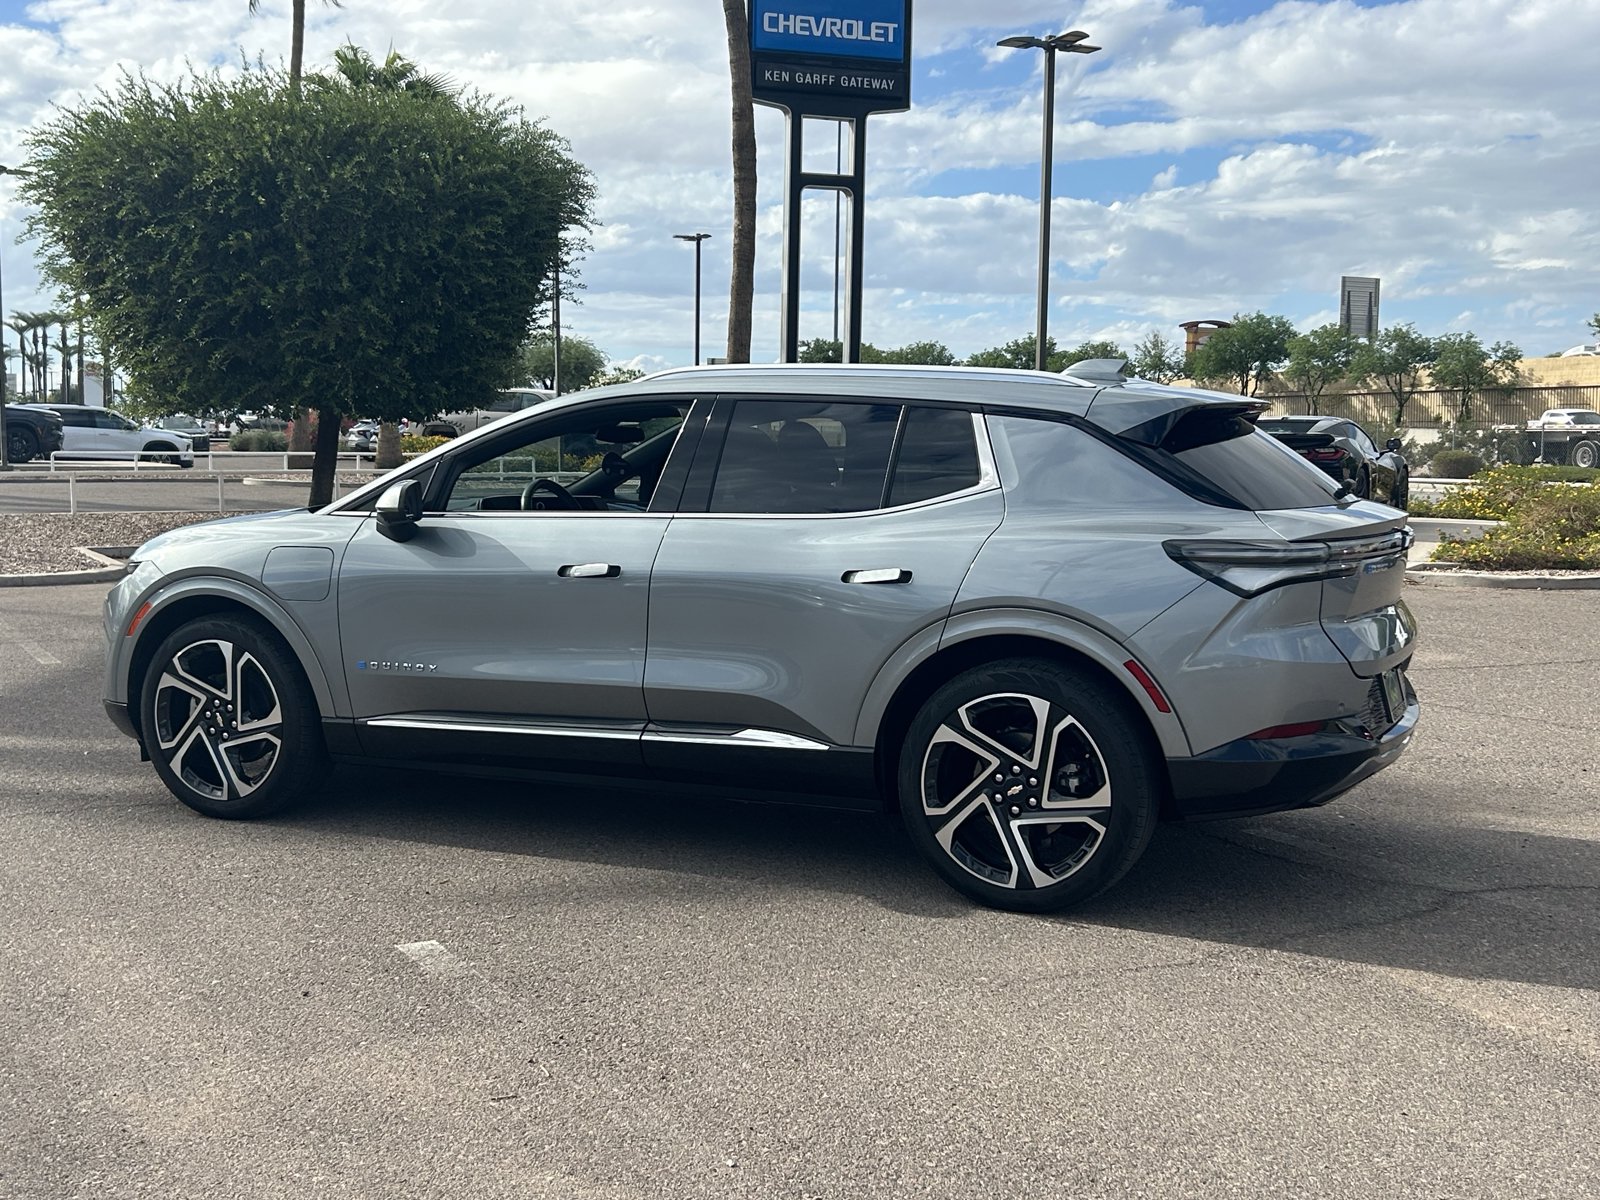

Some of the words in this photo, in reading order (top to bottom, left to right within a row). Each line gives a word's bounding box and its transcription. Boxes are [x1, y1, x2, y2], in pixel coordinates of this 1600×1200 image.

[763, 12, 898, 43] CHEVROLET
[764, 69, 790, 82] KEN
[795, 72, 836, 86] GARFF
[840, 75, 895, 90] GATEWAY
